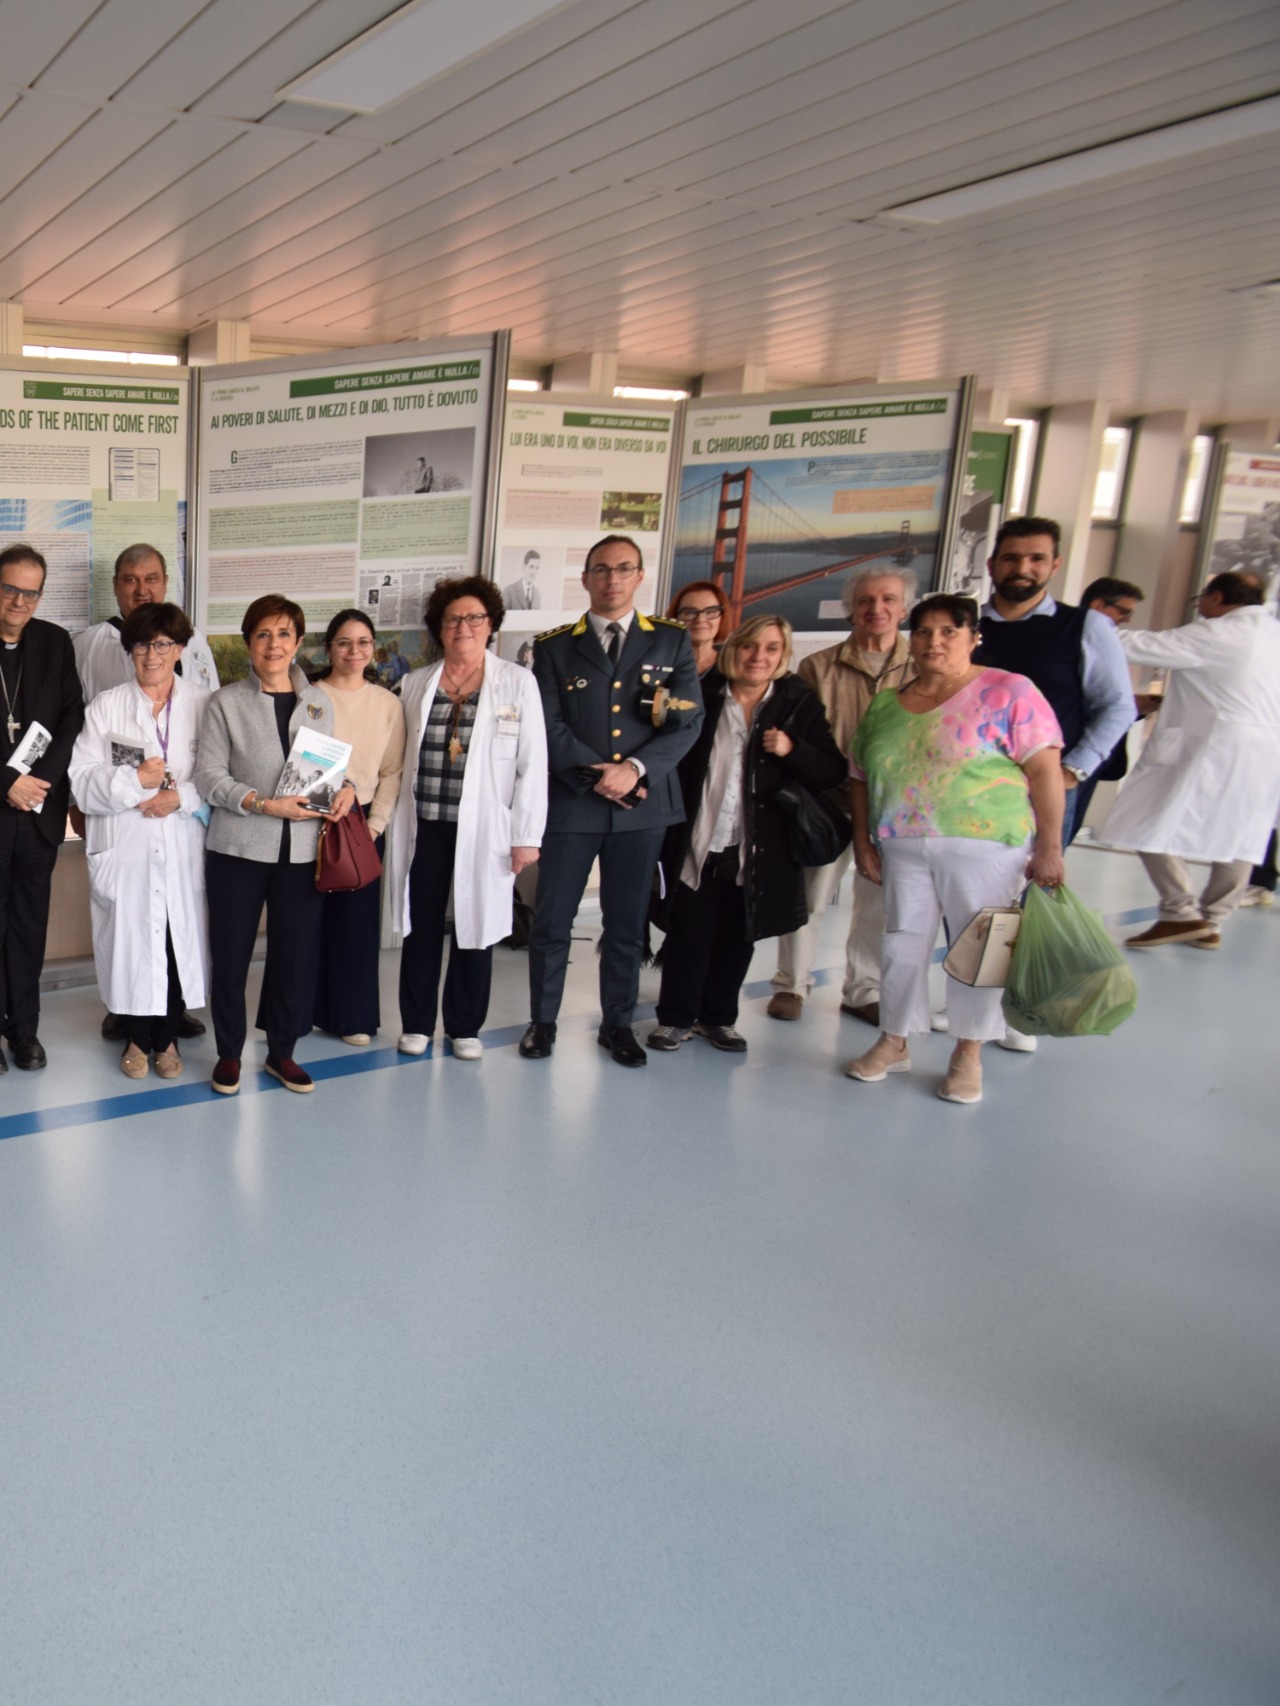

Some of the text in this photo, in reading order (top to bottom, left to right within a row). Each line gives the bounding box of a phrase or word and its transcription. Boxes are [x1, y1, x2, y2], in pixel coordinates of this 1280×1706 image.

[334, 378, 360, 389] SAPERE
[361, 375, 383, 387] SENZA
[384, 373, 410, 385] SAPERE
[412, 369, 436, 382] AMARE
[444, 365, 467, 378] NULLA
[63, 387, 85, 397] SAPERE
[85, 388, 104, 398] SENZA
[105, 389, 126, 398] SAPERE
[127, 390, 146, 399] AMARE
[147, 389, 151, 400] È
[152, 391, 170, 400] NULLA
[211, 389, 478, 429] AI POVERI DI SALUTE, DI MEZZI E DI DIO, TUTTO È DOVUTO
[19, 409, 34, 429] OF
[37, 411, 60, 430] THE
[63, 412, 110, 432] PATIENT
[113, 414, 144, 433] COME
[148, 415, 179, 434] FIRST
[510, 432, 522, 446] LUI
[523, 433, 538, 447] ERA
[540, 434, 556, 448] UNO
[557, 435, 564, 449] DI
[581, 436, 596, 450] NON
[598, 437, 611, 451] ERA
[613, 438, 643, 452] DIVERSO
[644, 439, 654, 453] DA
[656, 439, 667, 454] VOI
[692, 427, 868, 455] IL CHIRURGO DEL POSSIBILE
